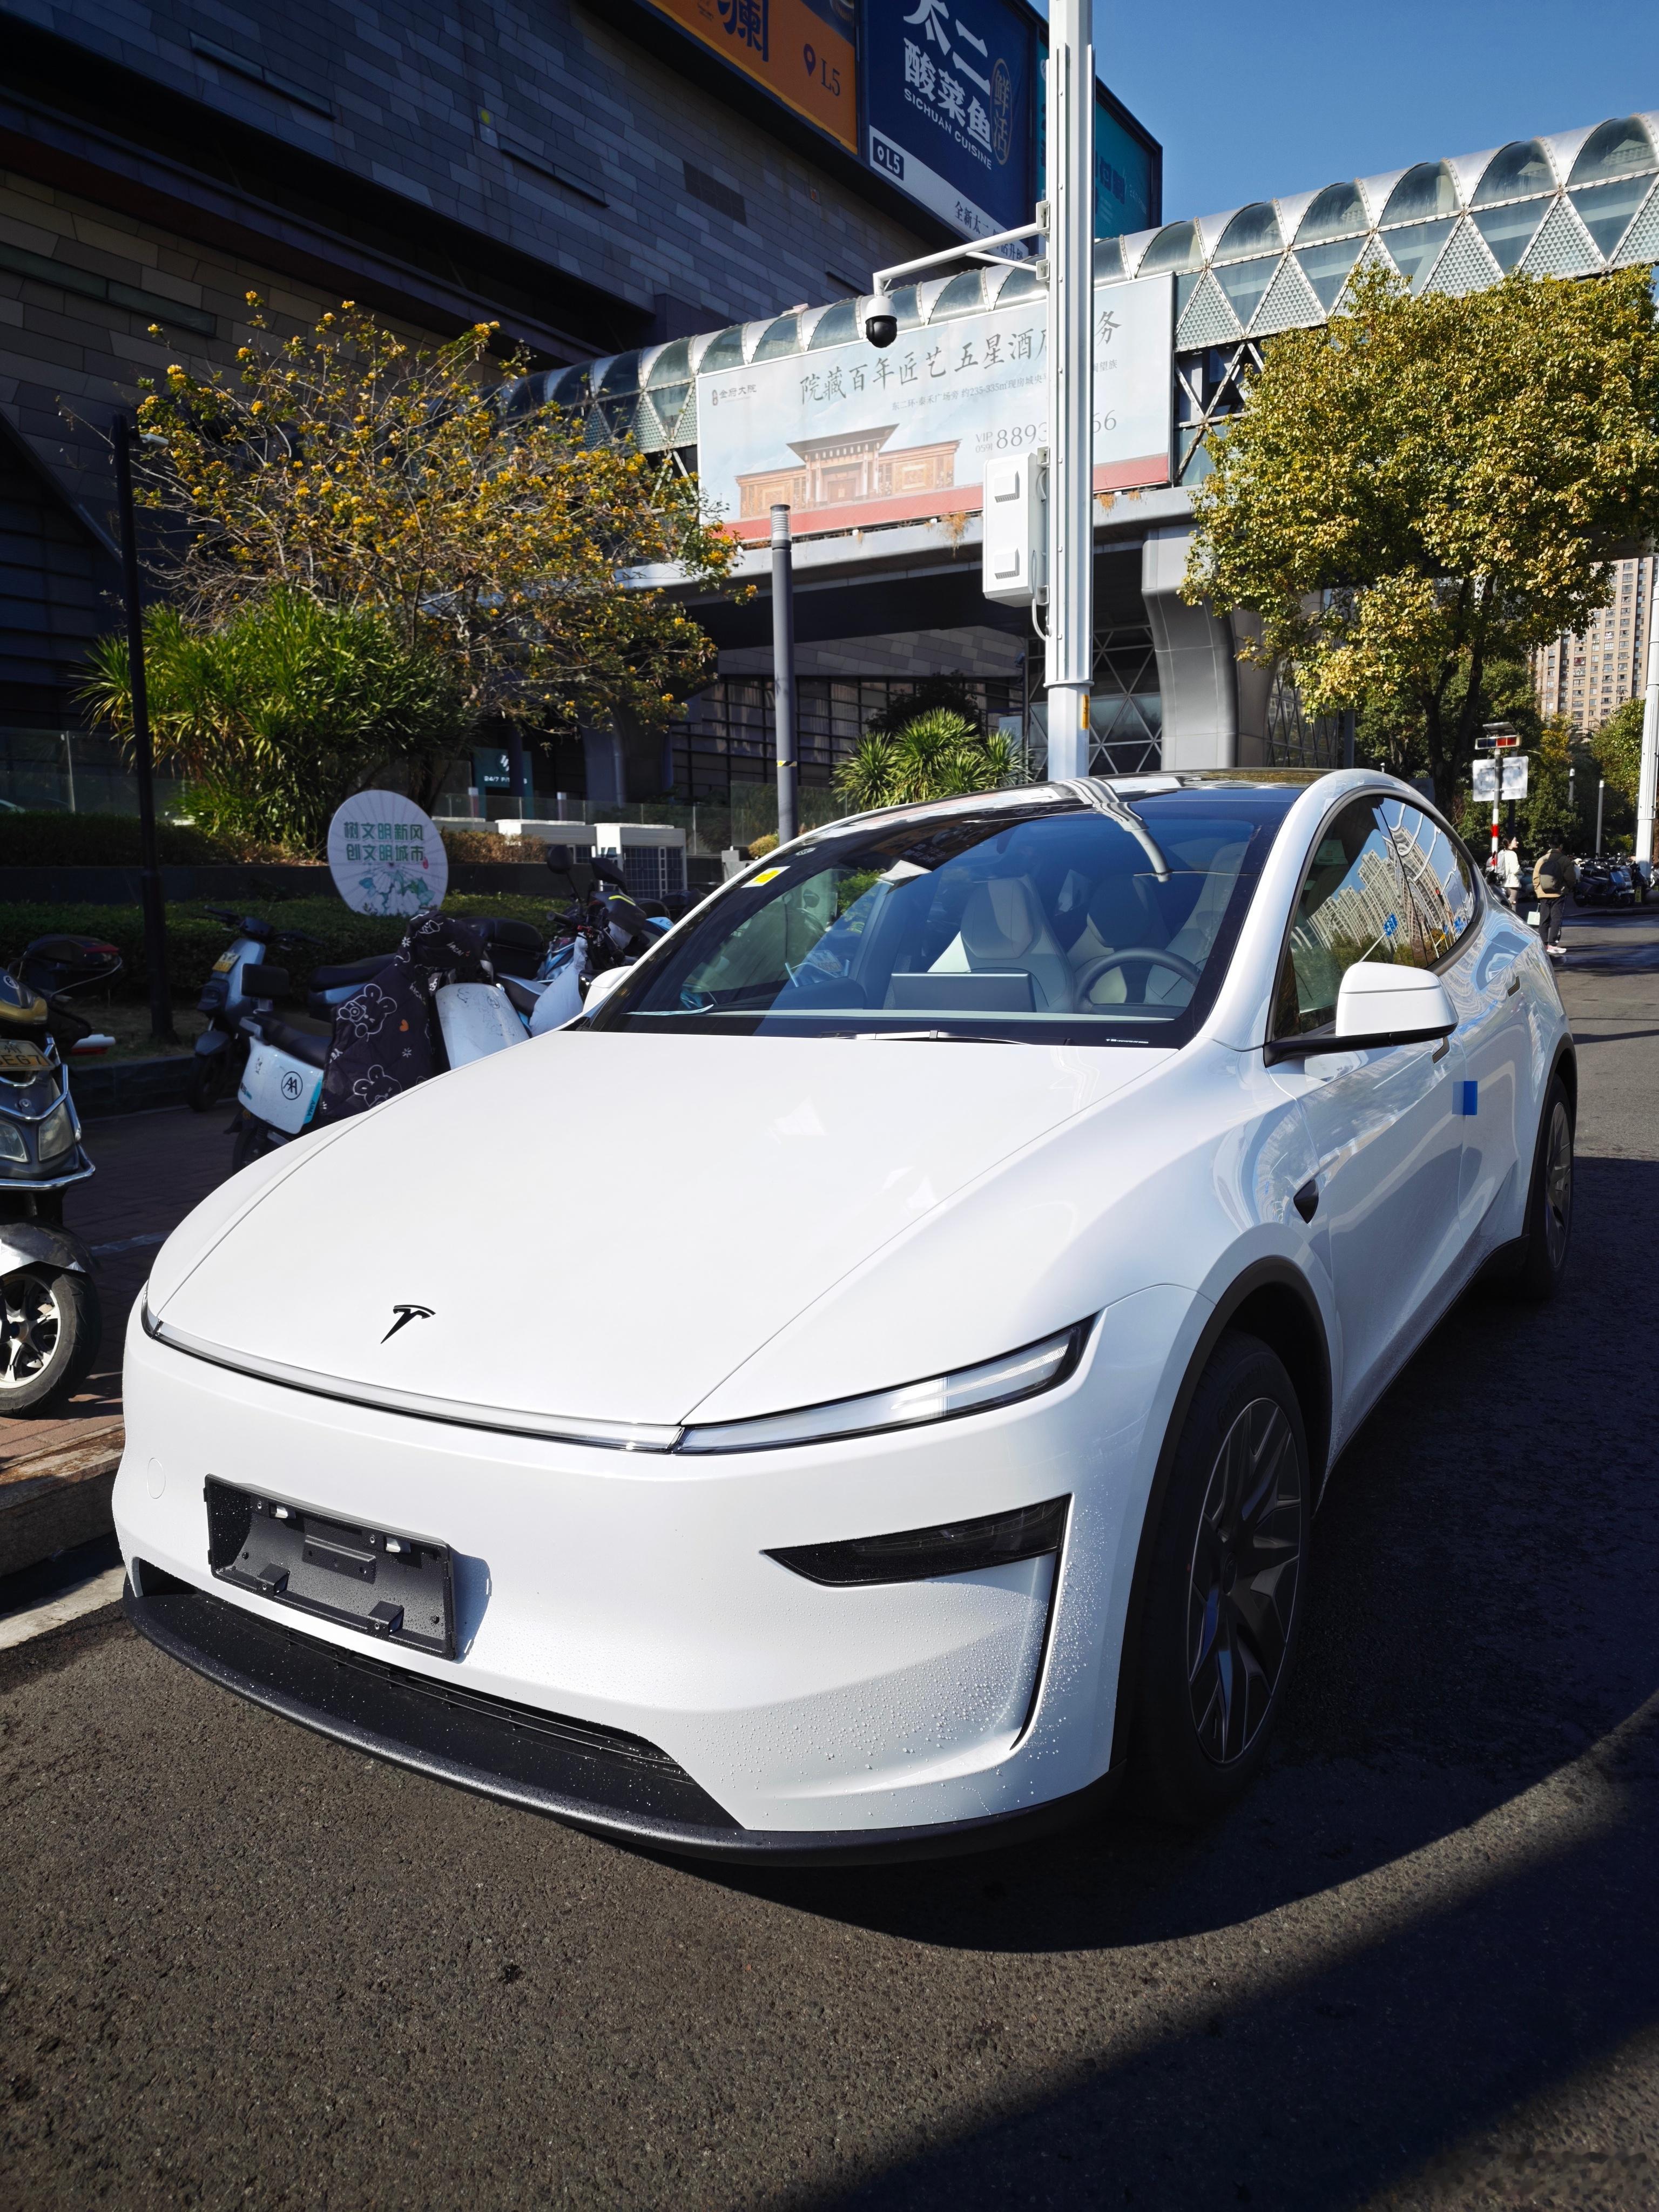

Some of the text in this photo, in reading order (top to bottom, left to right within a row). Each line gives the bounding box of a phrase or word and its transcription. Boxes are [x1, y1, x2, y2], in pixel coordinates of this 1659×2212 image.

[820, 58, 841, 97] L5
[903, 37, 993, 153] 酸菜鱼
[904, 88, 992, 171] SICHUAN CUISINE
[886, 148, 900, 175] L5
[975, 431, 993, 443] VIP
[975, 443, 993, 454] 0591
[343, 821, 424, 841] 树文明新风
[346, 844, 424, 862] 创文明城市
[0, 1055, 42, 1065] EG7
